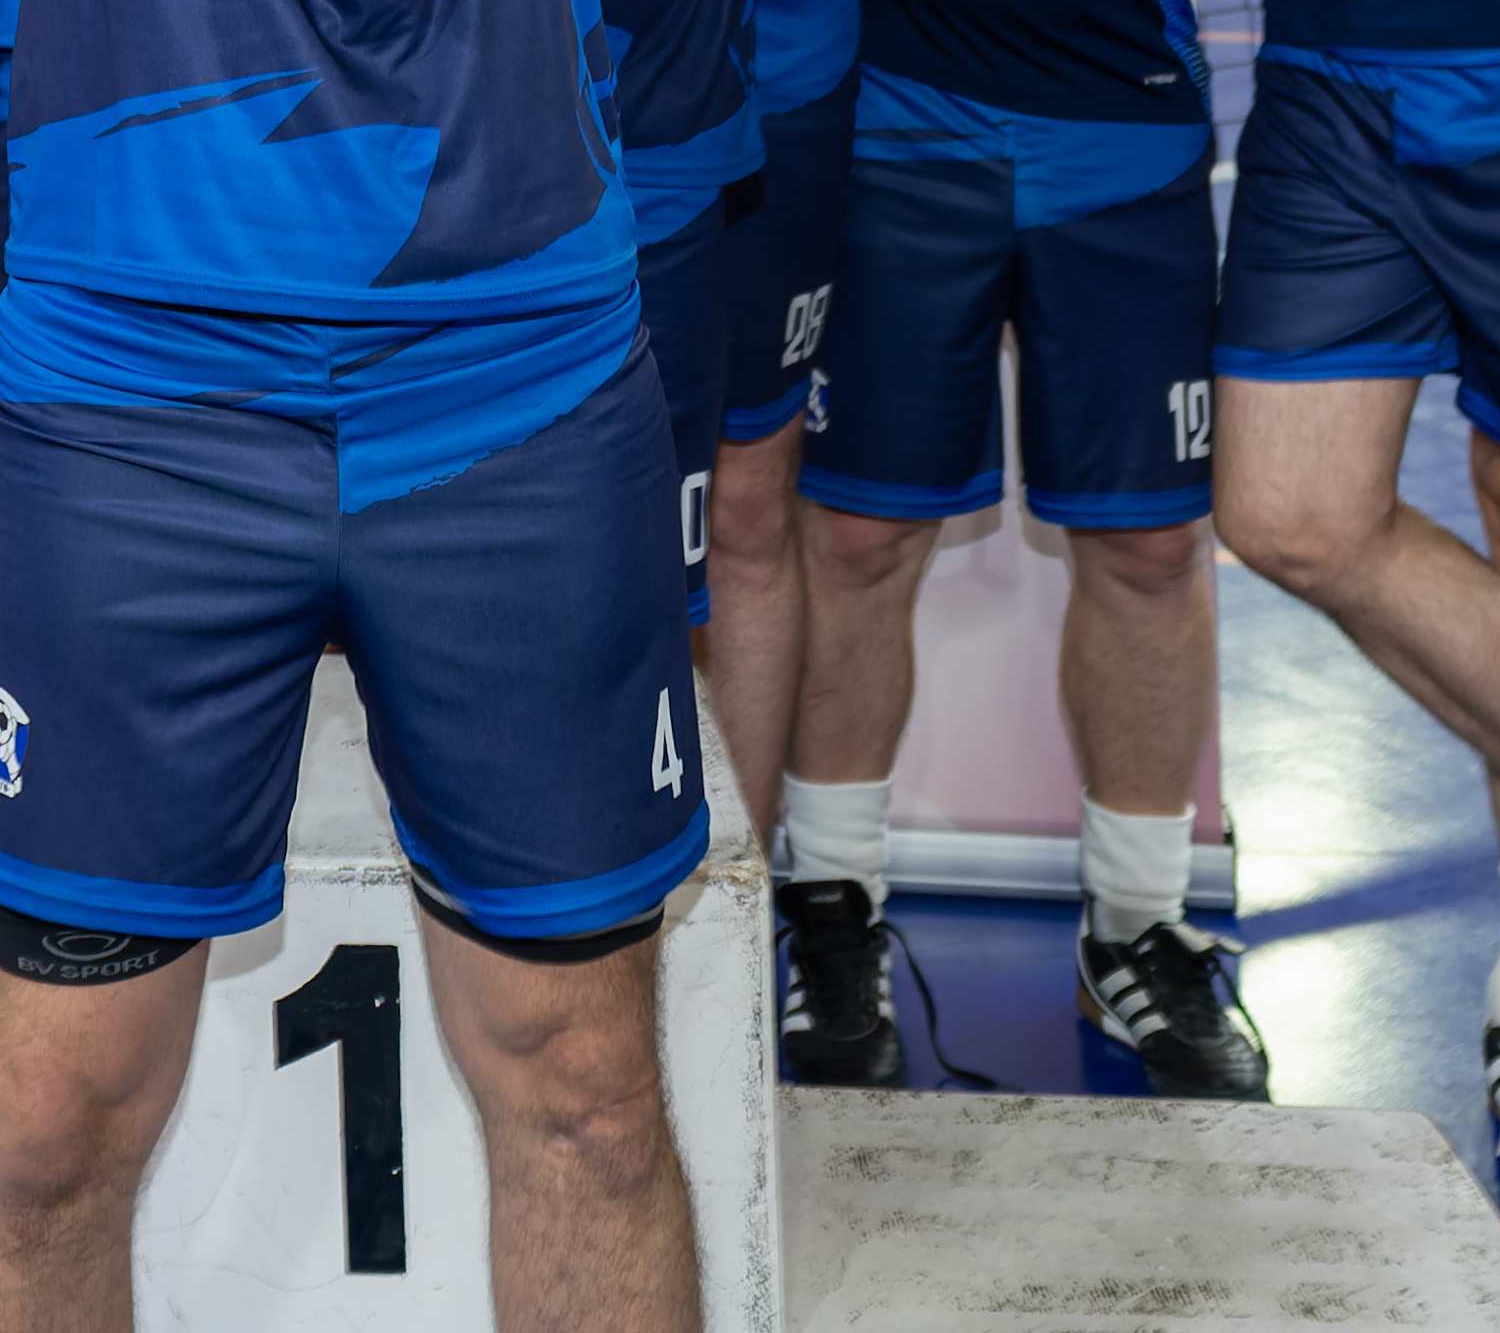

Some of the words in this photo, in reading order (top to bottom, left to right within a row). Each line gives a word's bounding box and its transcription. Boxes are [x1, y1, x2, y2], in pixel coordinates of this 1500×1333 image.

[780, 283, 834, 369] 28
[1168, 380, 1212, 463] 12
[650, 687, 684, 799] 4
[16, 956, 55, 976] BV
[60, 948, 160, 980] SPORT
[273, 945, 407, 1274] 1
